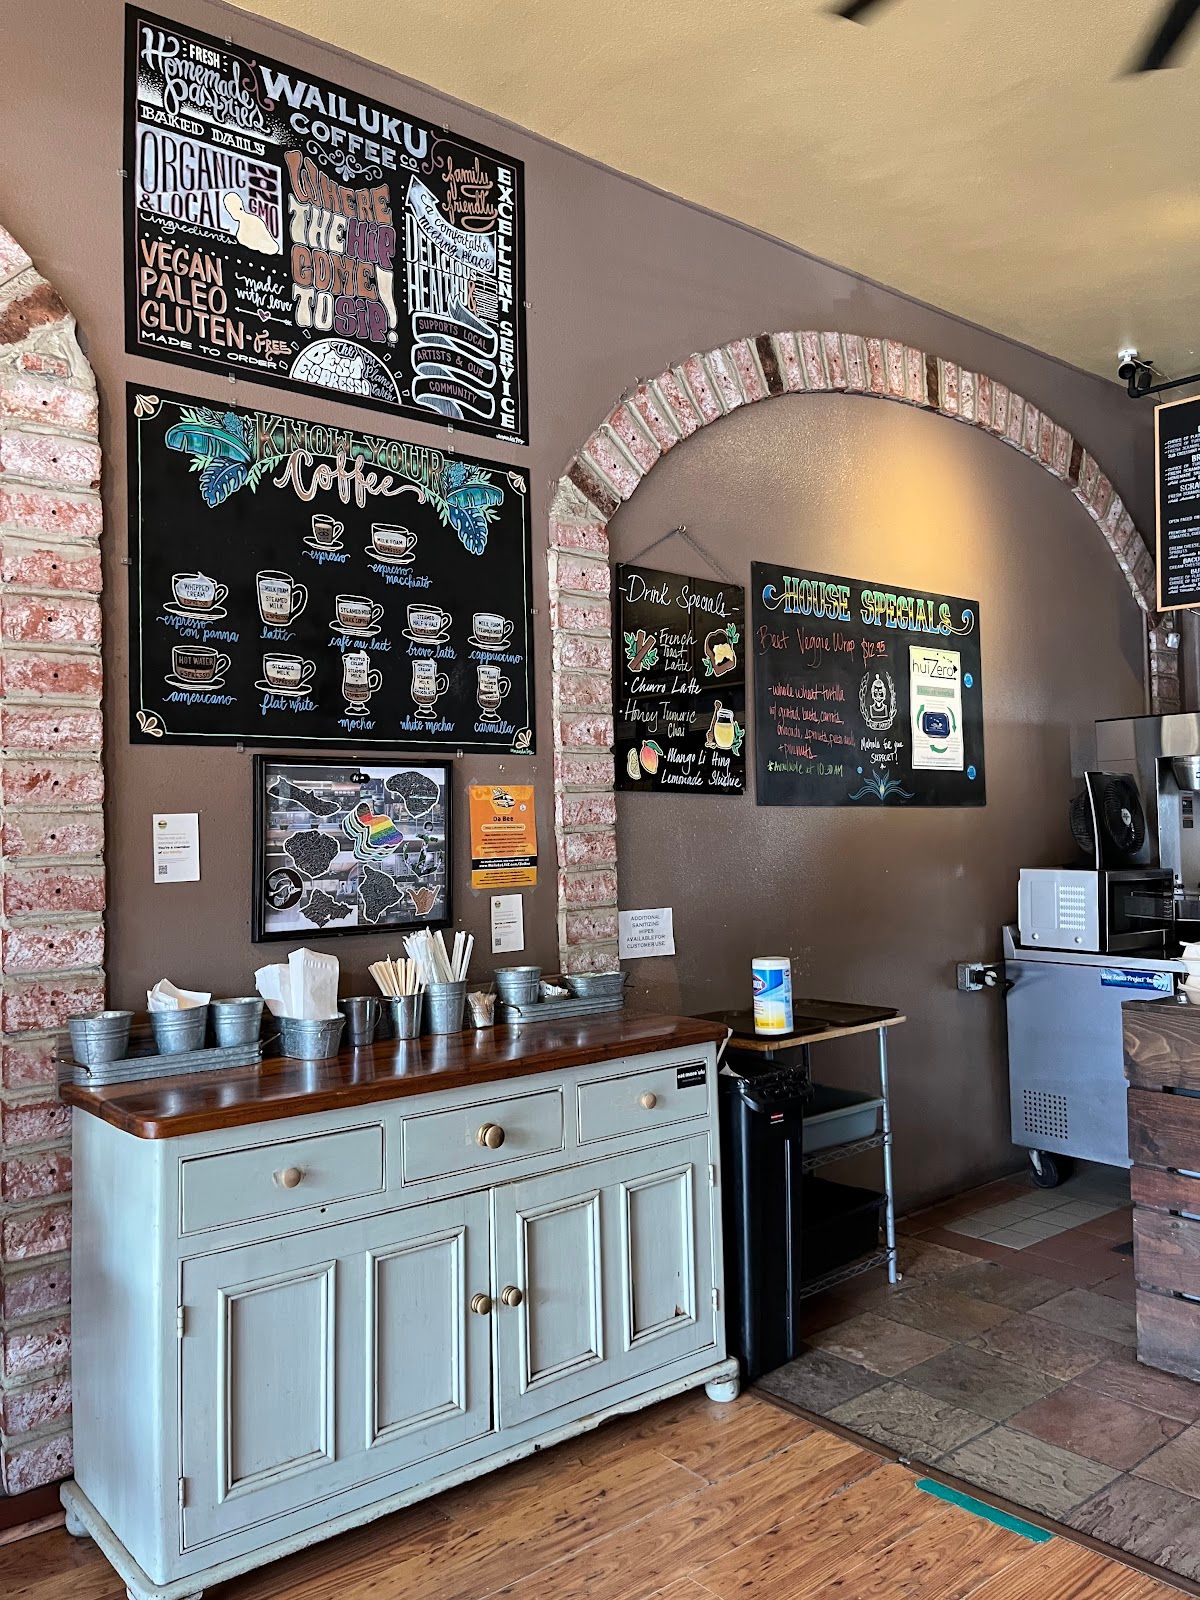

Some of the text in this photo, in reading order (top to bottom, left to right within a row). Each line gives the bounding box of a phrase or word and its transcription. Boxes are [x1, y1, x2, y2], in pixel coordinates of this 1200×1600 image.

[141, 27, 254, 108] Homemade
[189, 43, 220, 69] FRESH
[163, 78, 270, 133] Pastries
[259, 65, 428, 159] WAILUKU
[141, 105, 266, 156] BAKED DAILY
[289, 113, 397, 170] COFFEE
[140, 131, 246, 193] ORGANIC
[284, 150, 393, 225] WHERE
[157, 191, 230, 232] LOCAL
[249, 198, 279, 239] GMO
[442, 181, 497, 231] friendly
[140, 212, 238, 245] ingredients
[288, 193, 347, 254] THE
[435, 218, 489, 253] comfortable
[497, 167, 513, 313] EXCELLENT
[405, 212, 477, 282] DELICIOUS
[419, 215, 493, 271] meeting place
[140, 239, 224, 286] VEGAN
[291, 244, 378, 302] COME
[140, 267, 227, 315] PALEO
[235, 272, 285, 295] made
[407, 261, 468, 318] HEALTHY
[292, 283, 334, 331] TO
[142, 330, 278, 369] MADE TO ORDER
[418, 319, 488, 350] SUPPORTS LOCAL
[293, 354, 370, 396] ESPRESSO
[305, 342, 364, 379] BEST
[417, 350, 484, 379] ARTISTS & OUR
[499, 320, 515, 429] SERVICE
[429, 381, 478, 404] COMMUNITY
[254, 412, 445, 495] KNOW YOUR
[273, 450, 427, 508] Coffee
[302, 550, 351, 565] espresso
[367, 563, 413, 577] espresso
[184, 583, 210, 593] WHIPPED
[386, 575, 433, 588] macchiato
[156, 614, 213, 630] espresso
[783, 576, 952, 636] HOUSE SPECIALS
[179, 627, 239, 643] con panna
[260, 626, 296, 641] latte
[369, 638, 391, 651] lait
[660, 628, 697, 645] French
[796, 627, 831, 669] Veggie
[832, 633, 855, 662] Wrap
[178, 655, 214, 666] HOT WATER
[433, 644, 457, 659] latte
[468, 650, 523, 665] cappuccino
[660, 644, 687, 658] Toast
[665, 659, 692, 672] Latte
[162, 691, 237, 705] americano
[631, 676, 702, 694] Churro Latte
[795, 684, 821, 700] wheat
[259, 694, 319, 716] flat white
[625, 698, 658, 733] Honey
[338, 719, 376, 732] mocha
[425, 717, 455, 734] mocha
[667, 723, 685, 738] Chai
[661, 769, 703, 786] Lemonade
[667, 748, 730, 777] Mango Li Hing
